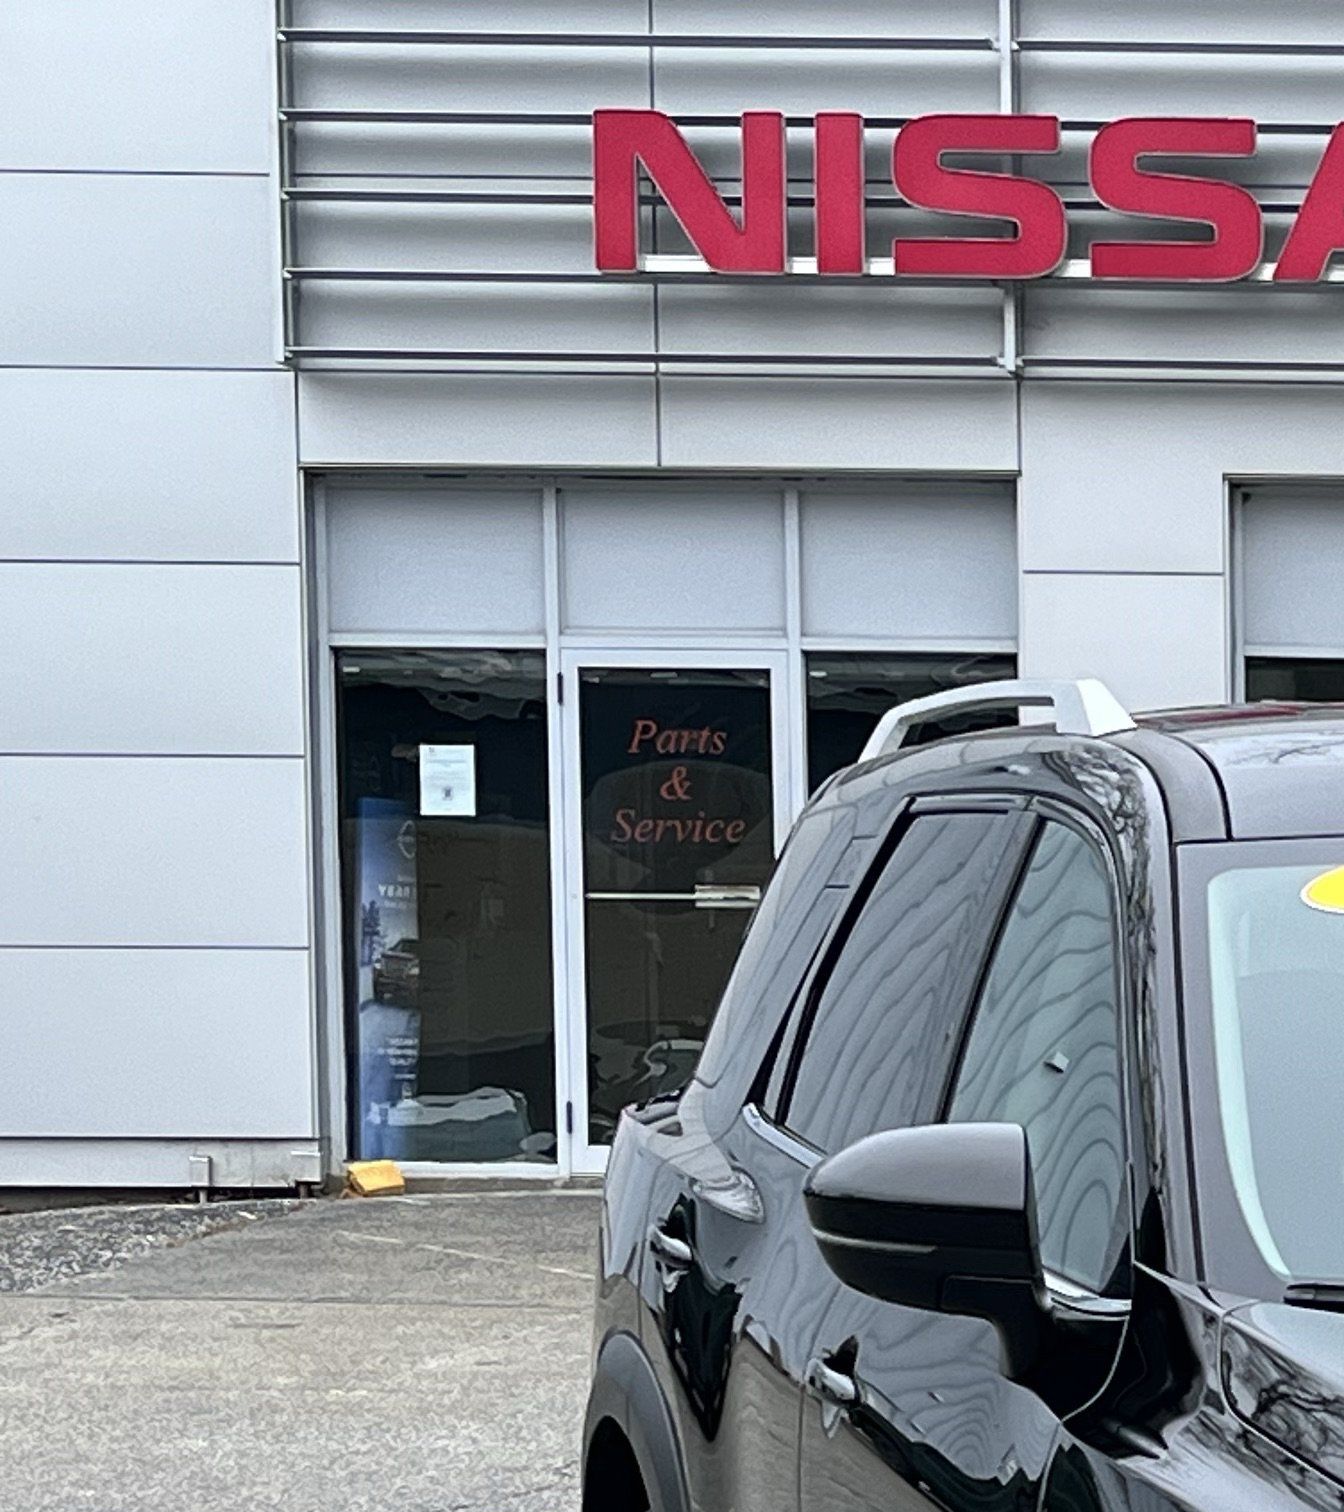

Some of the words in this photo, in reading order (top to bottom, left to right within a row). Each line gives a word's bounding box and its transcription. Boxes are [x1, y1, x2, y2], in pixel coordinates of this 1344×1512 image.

[627, 719, 727, 754] Parts
[659, 765, 692, 800] &
[611, 808, 746, 843] Service
